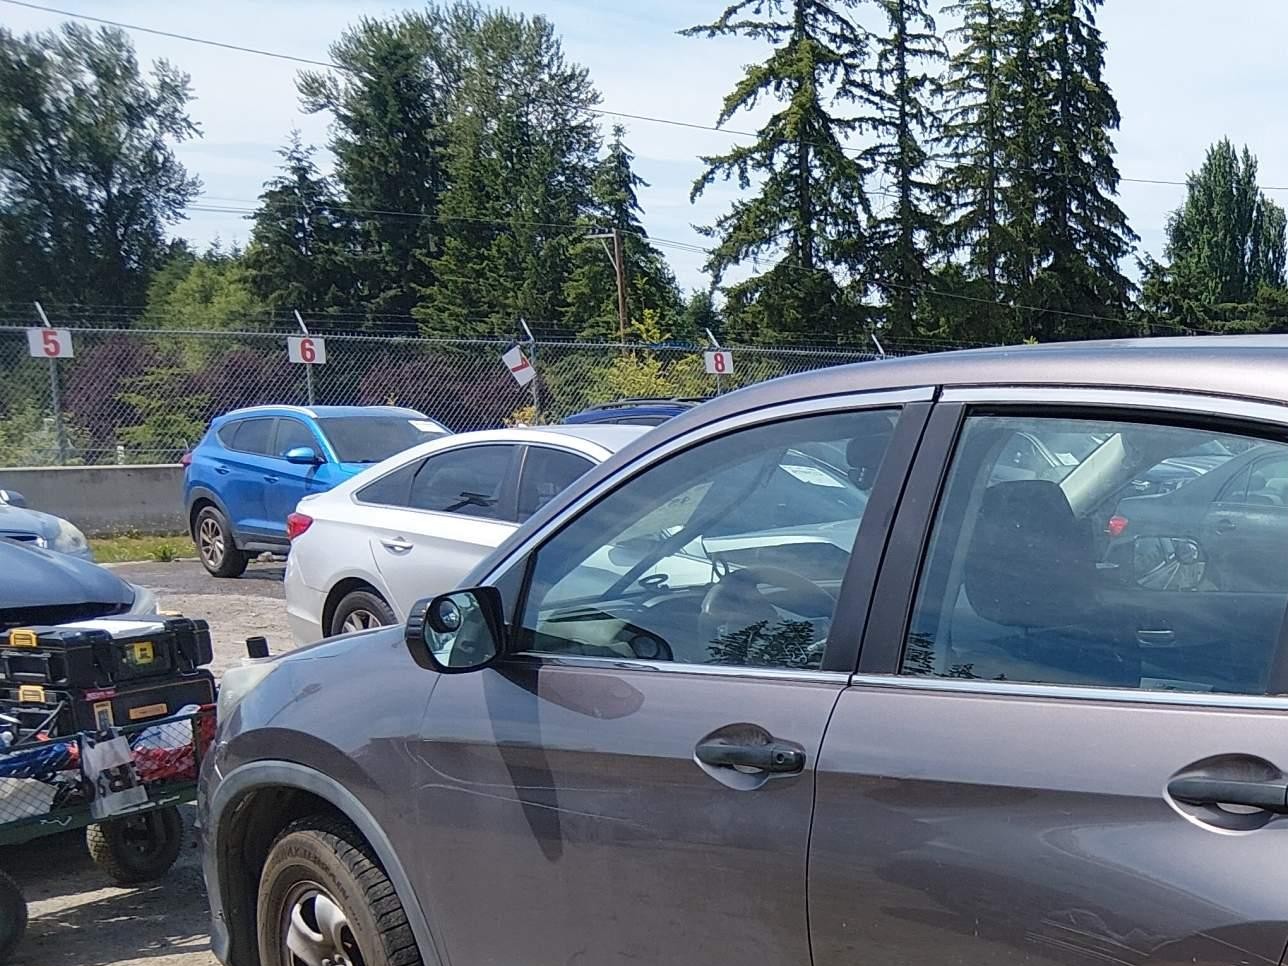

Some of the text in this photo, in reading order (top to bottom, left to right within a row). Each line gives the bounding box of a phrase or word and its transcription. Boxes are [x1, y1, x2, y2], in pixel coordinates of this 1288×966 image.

[42, 331, 60, 356] 5
[300, 339, 316, 362] 6
[714, 353, 725, 372] 8
